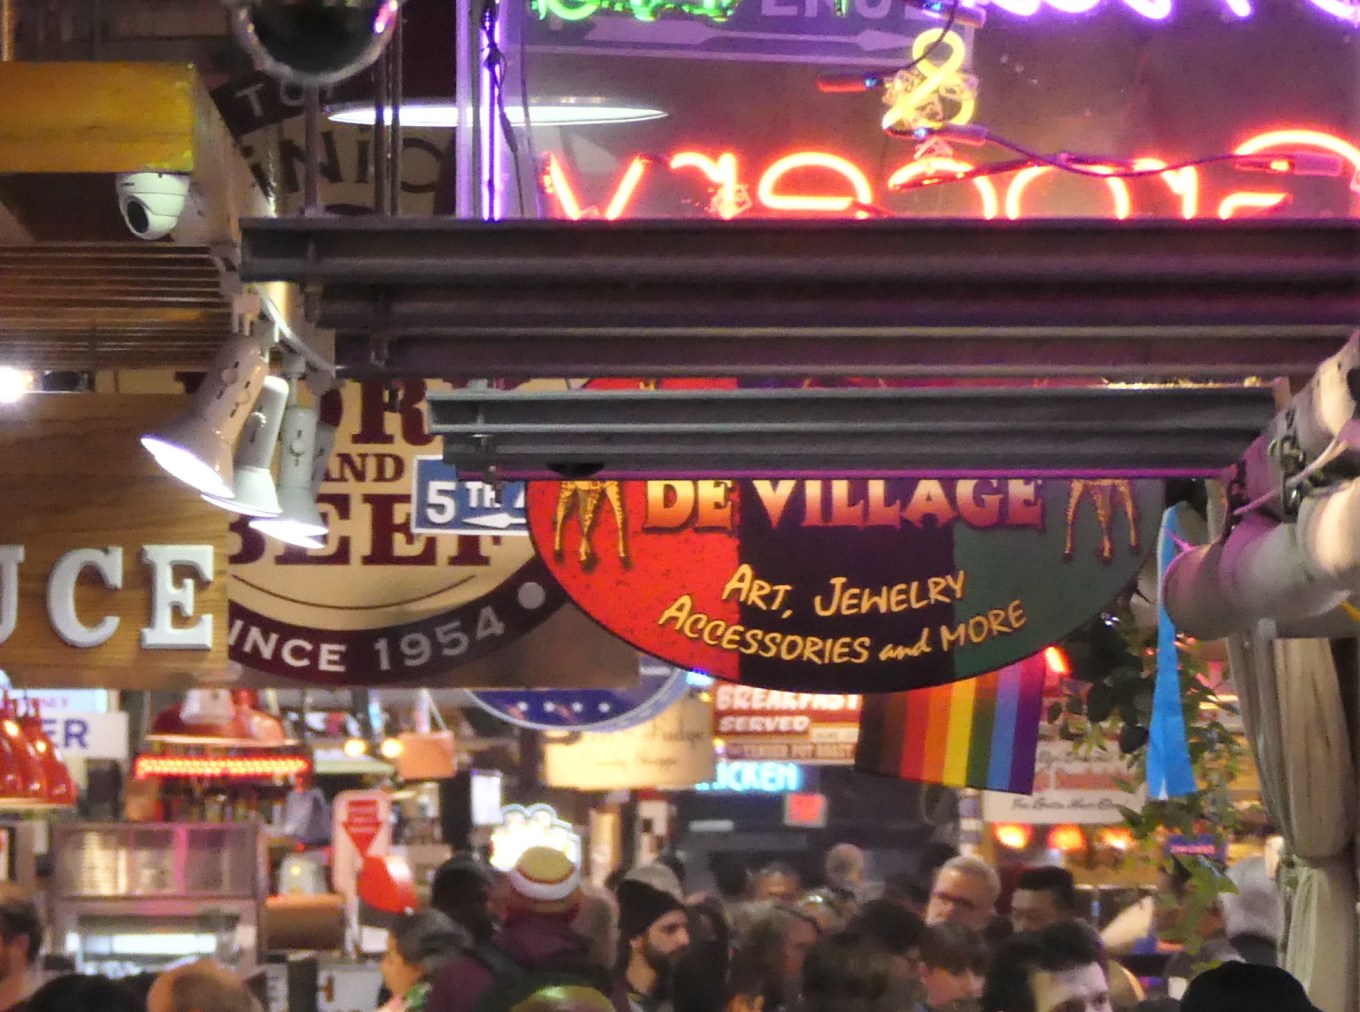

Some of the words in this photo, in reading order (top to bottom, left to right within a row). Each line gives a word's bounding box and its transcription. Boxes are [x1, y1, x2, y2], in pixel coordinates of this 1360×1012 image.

[643, 479, 734, 529] DE
[752, 479, 1044, 531] VILLAGE
[814, 570, 965, 618] JEWELRY
[229, 620, 347, 673] INCE
[374, 606, 505, 672] 1954
[658, 594, 870, 664] ACCESSORIES
[879, 627, 932, 662] and
[941, 600, 1027, 652] MORE
[716, 684, 858, 711] BREAKFAST
[720, 715, 810, 732] SERVED
[696, 761, 800, 792] ICKEN
